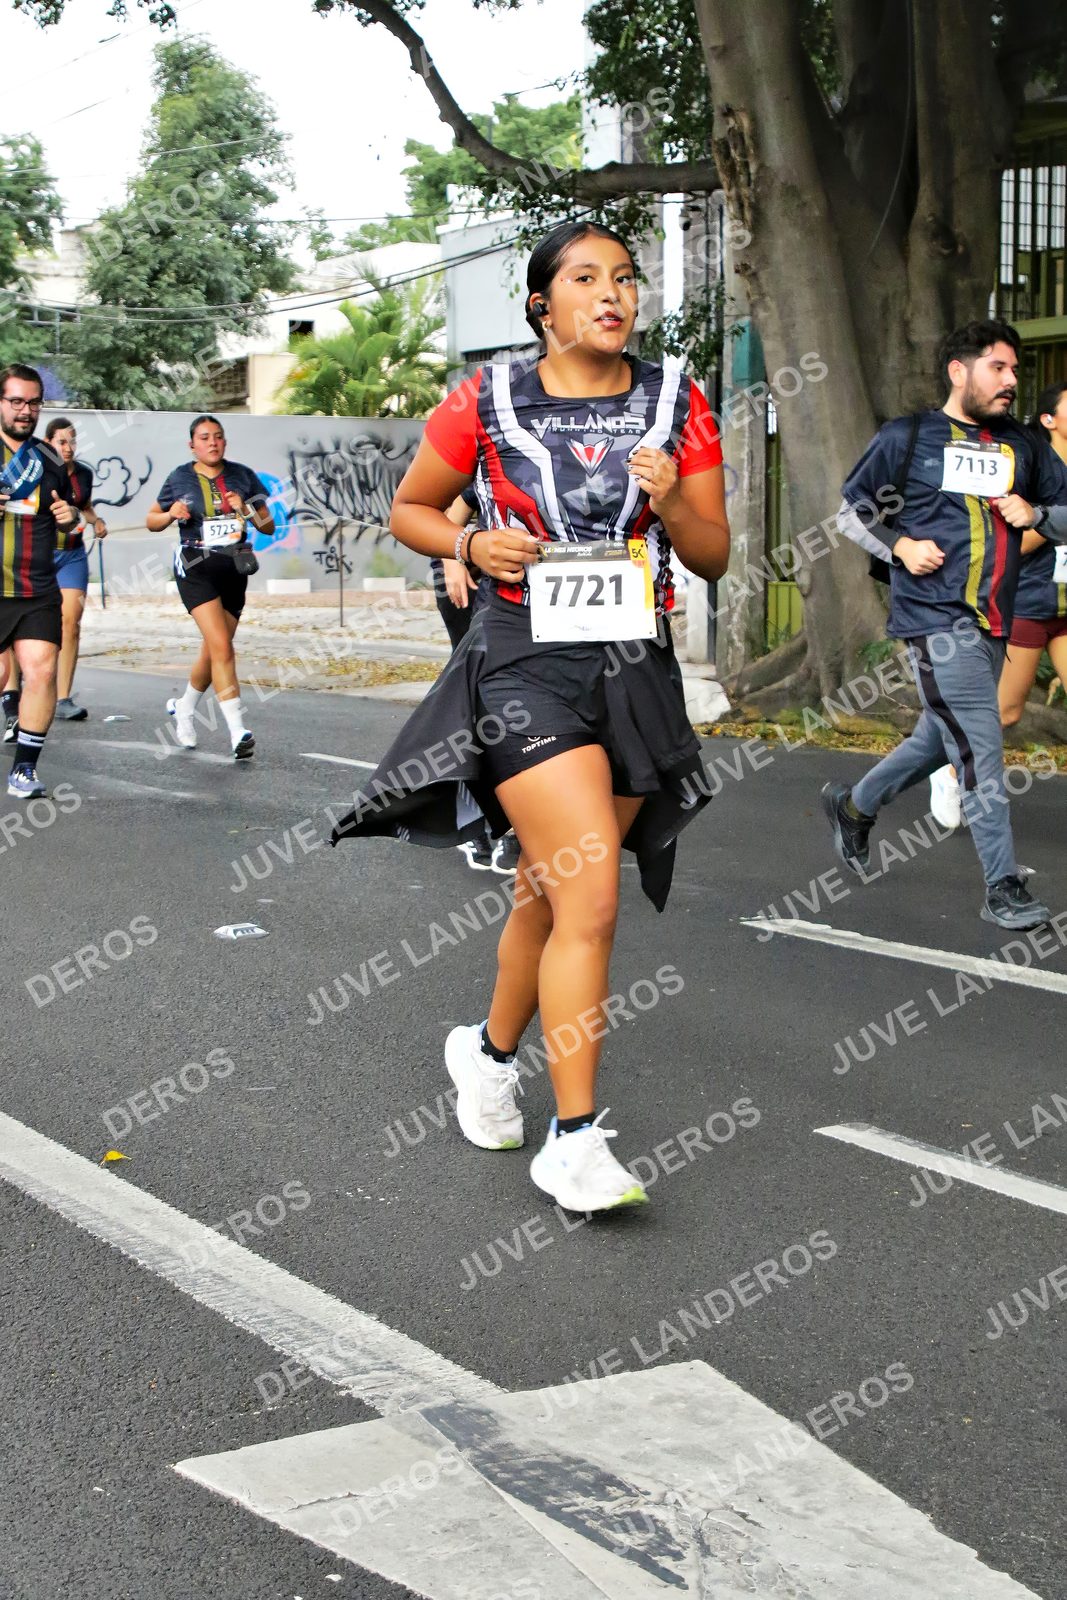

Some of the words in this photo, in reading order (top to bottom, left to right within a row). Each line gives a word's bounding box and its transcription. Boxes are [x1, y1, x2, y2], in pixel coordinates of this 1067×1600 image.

[531, 411, 646, 440] VILLANOS
[955, 455, 998, 476] 7113
[210, 524, 236, 536] 5725
[632, 548, 644, 558] 5K
[545, 574, 622, 607] 7721
